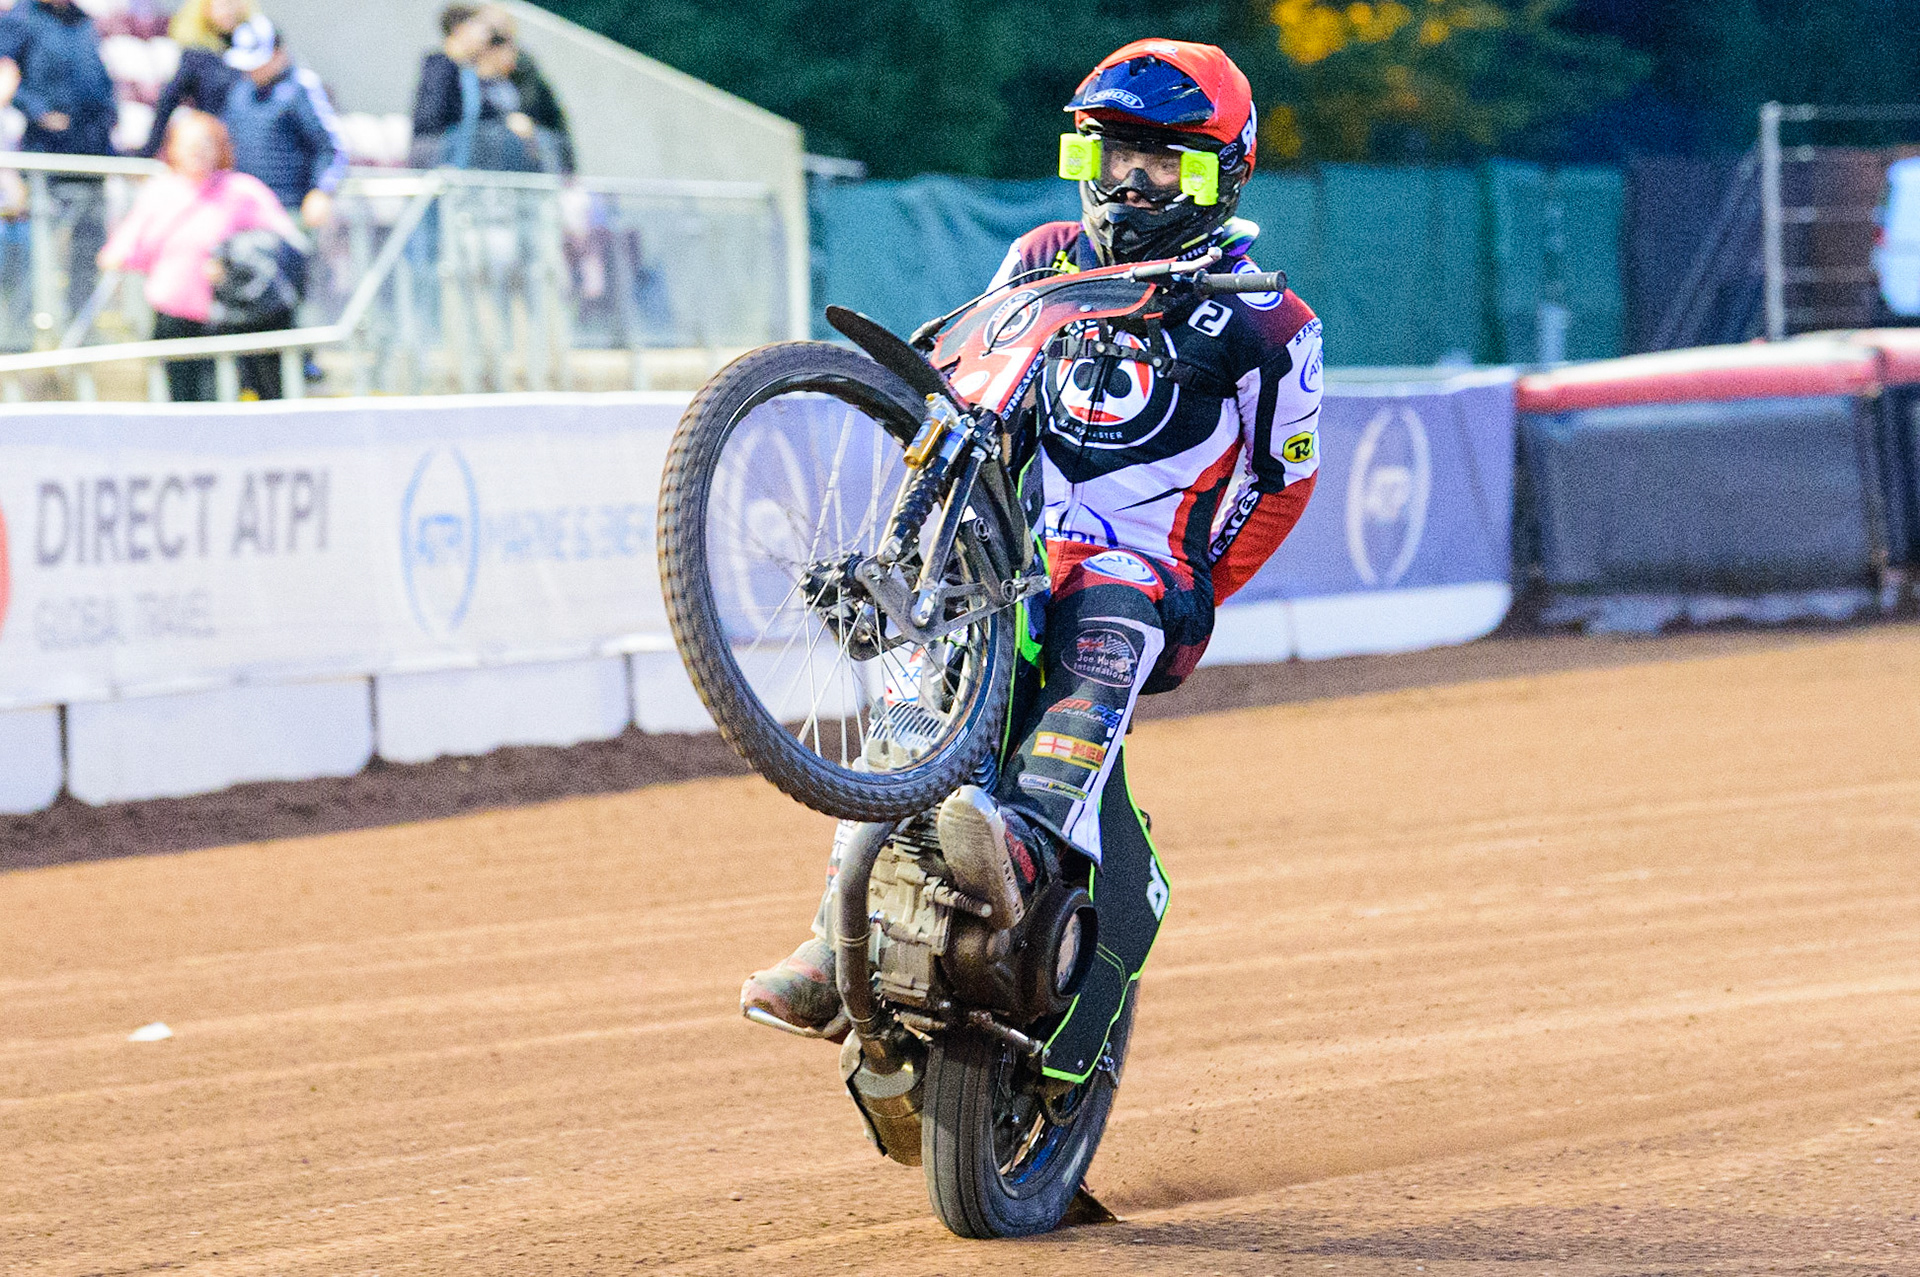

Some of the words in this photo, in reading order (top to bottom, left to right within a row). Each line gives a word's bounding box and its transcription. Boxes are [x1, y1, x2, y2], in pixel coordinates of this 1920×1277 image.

[1094, 89, 1138, 106] SHOEI
[1194, 301, 1225, 334] 2
[36, 472, 218, 567] DIRECT
[231, 467, 329, 556] ATPI
[1077, 654, 1095, 663] Joe
[1073, 662, 1132, 683] International
